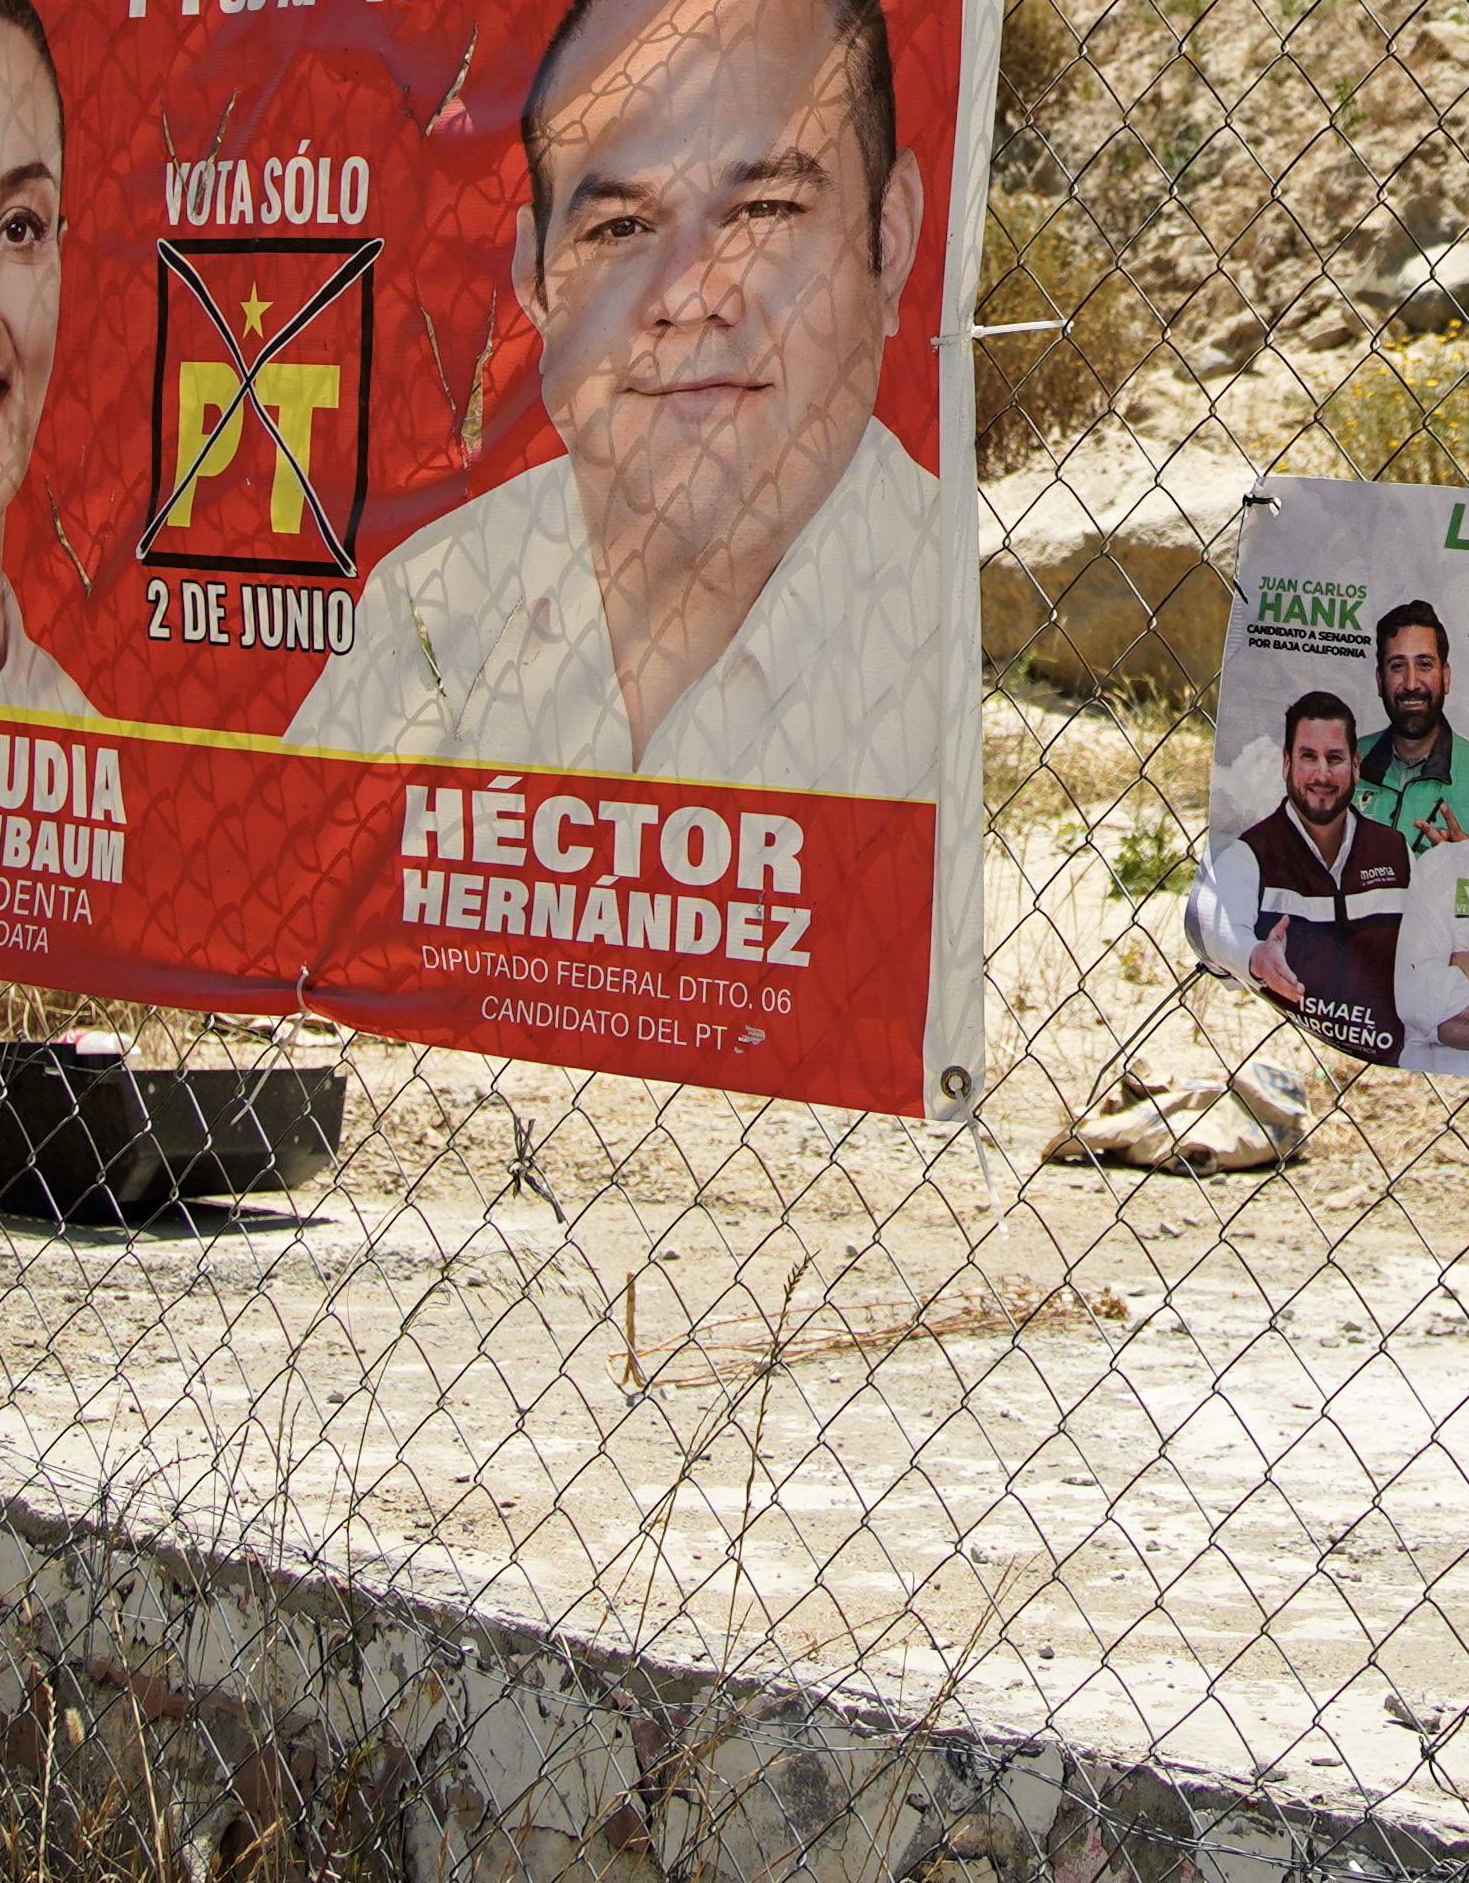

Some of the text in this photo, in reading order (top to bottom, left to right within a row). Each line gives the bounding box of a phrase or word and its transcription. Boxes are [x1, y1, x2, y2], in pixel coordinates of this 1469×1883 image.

[165, 139, 369, 226] VOTA SÓLO
[167, 361, 340, 534] PT
[147, 578, 356, 656] 2 DE JUNIO
[1258, 592, 1364, 631] HANK
[1259, 576, 1367, 599] JUAN CARLOS
[401, 774, 805, 894] HÉCTOR
[402, 874, 811, 967] HERNÁNDEZ
[421, 945, 791, 1015] DIPUTADO FEDERAL DTTO. 06
[1300, 996, 1375, 1025] ISMAEL
[481, 995, 727, 1051] CANDIDATO DEL PT
